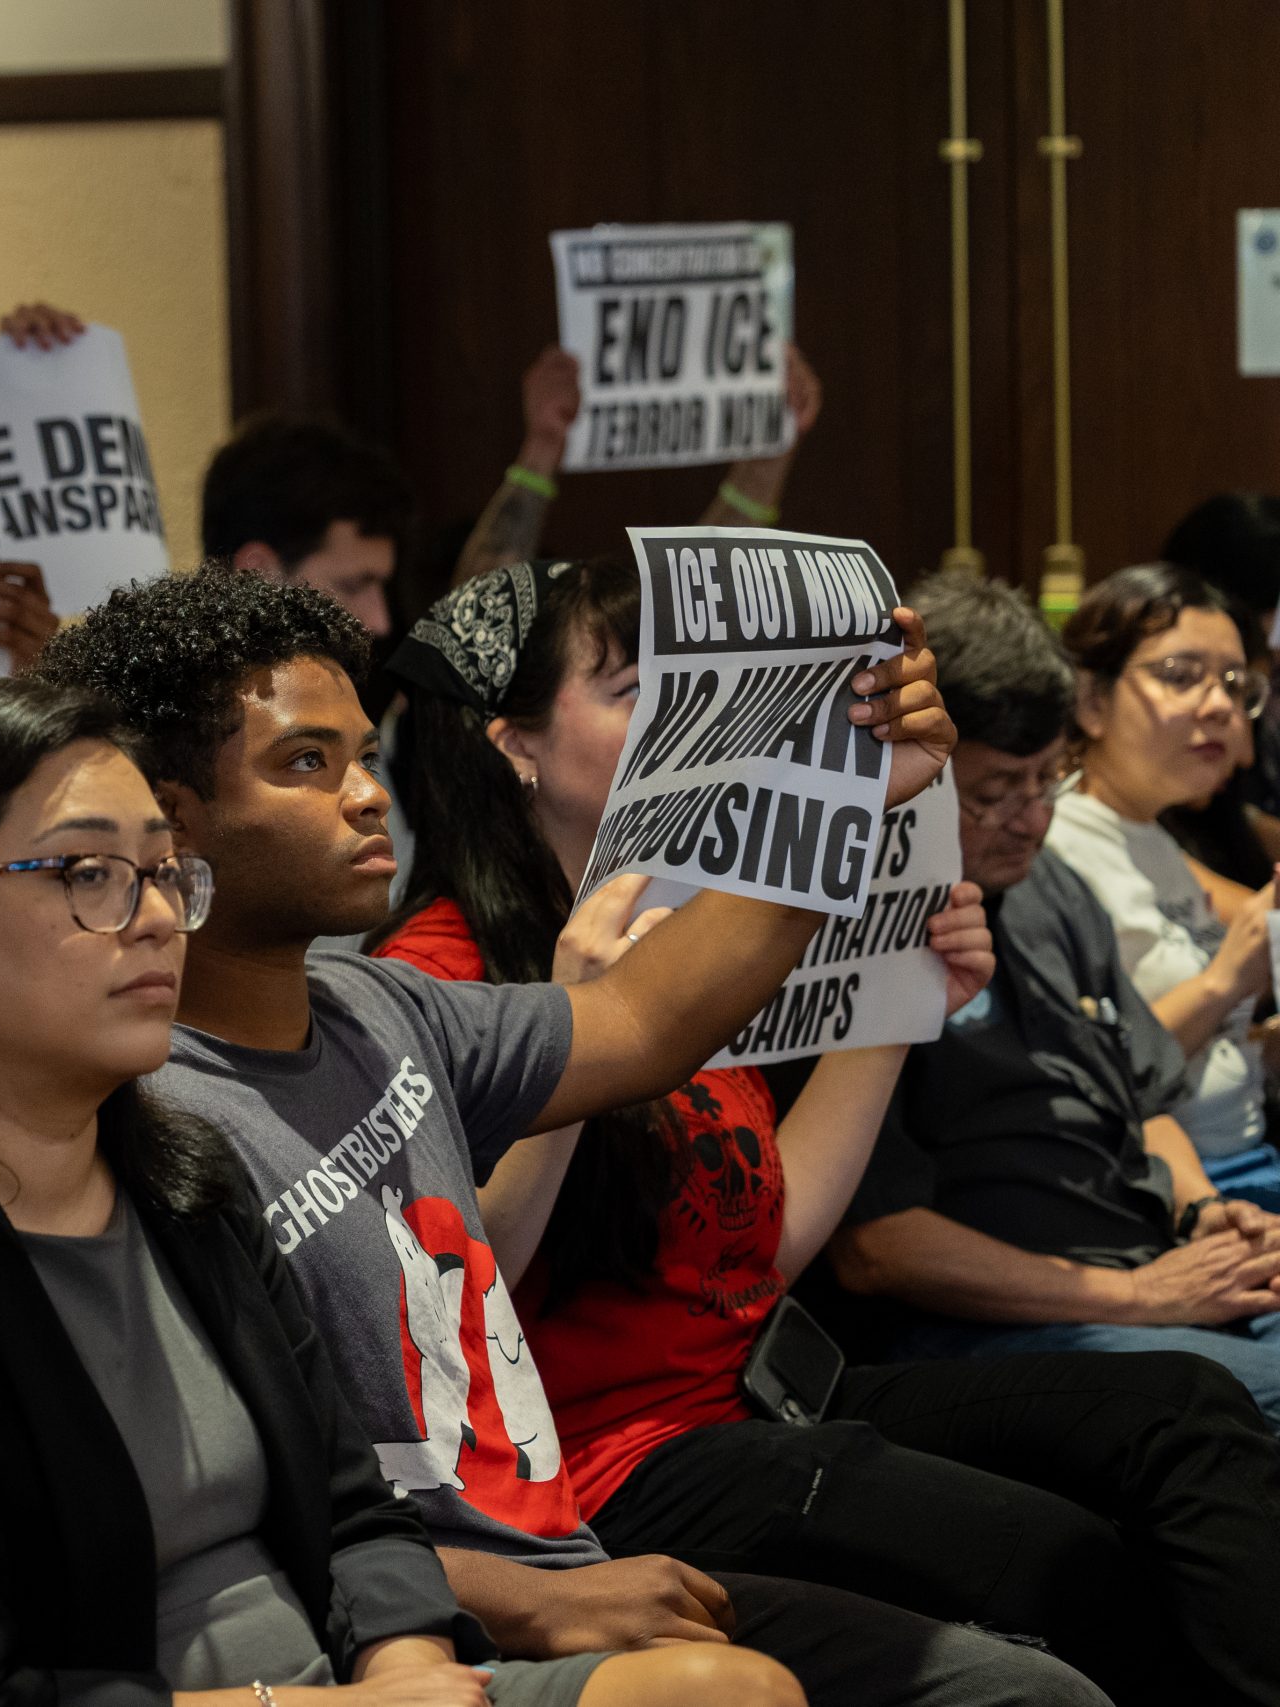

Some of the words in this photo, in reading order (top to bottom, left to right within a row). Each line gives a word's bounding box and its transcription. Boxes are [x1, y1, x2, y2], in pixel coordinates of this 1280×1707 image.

[596, 298, 686, 385] END
[665, 547, 727, 643] ICE
[730, 547, 798, 641] OUT
[798, 548, 891, 638] NOW!
[616, 669, 719, 792] NO
[672, 654, 888, 780] HUMAN
[264, 1055, 434, 1255] GHOSTBUSTERS
